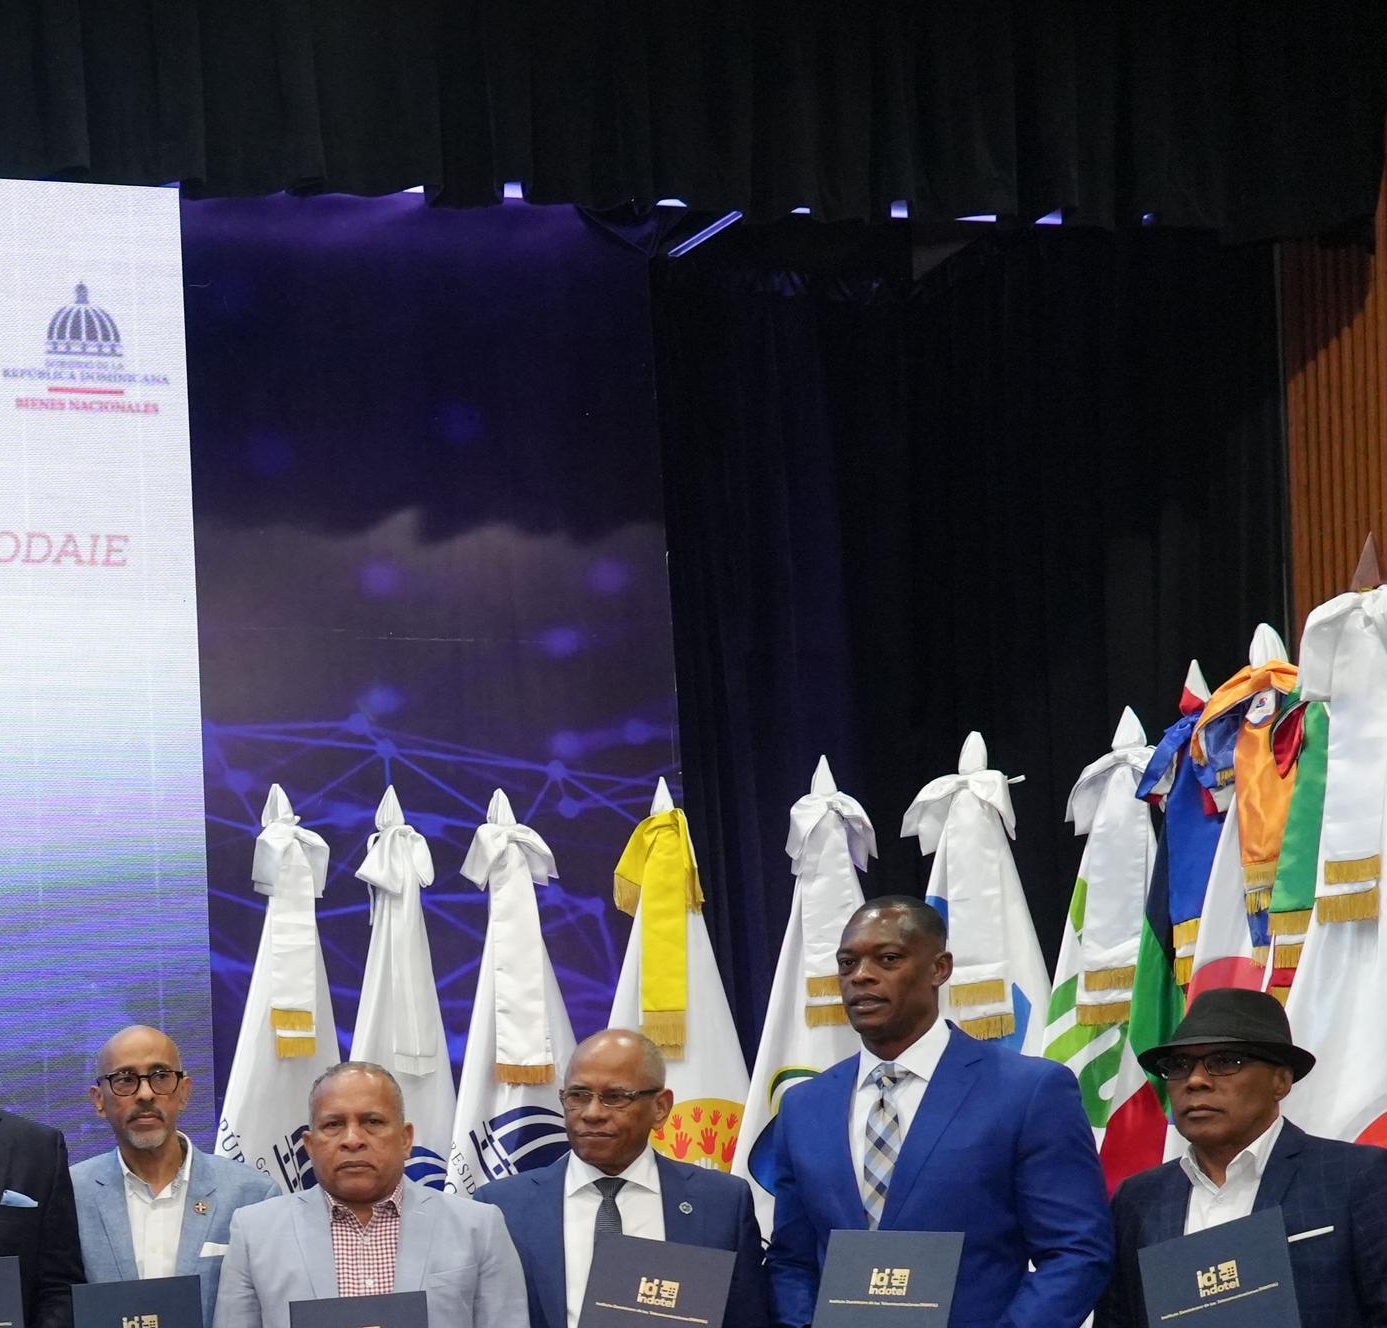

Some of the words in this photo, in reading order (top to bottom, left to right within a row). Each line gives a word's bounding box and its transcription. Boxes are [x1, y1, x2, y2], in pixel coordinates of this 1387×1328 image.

[15, 398, 65, 411] BIENES
[69, 399, 160, 415] NACIONALES
[868, 1285, 907, 1296] indotel
[1198, 1277, 1241, 1298] indotel
[636, 1293, 677, 1309] indotel
